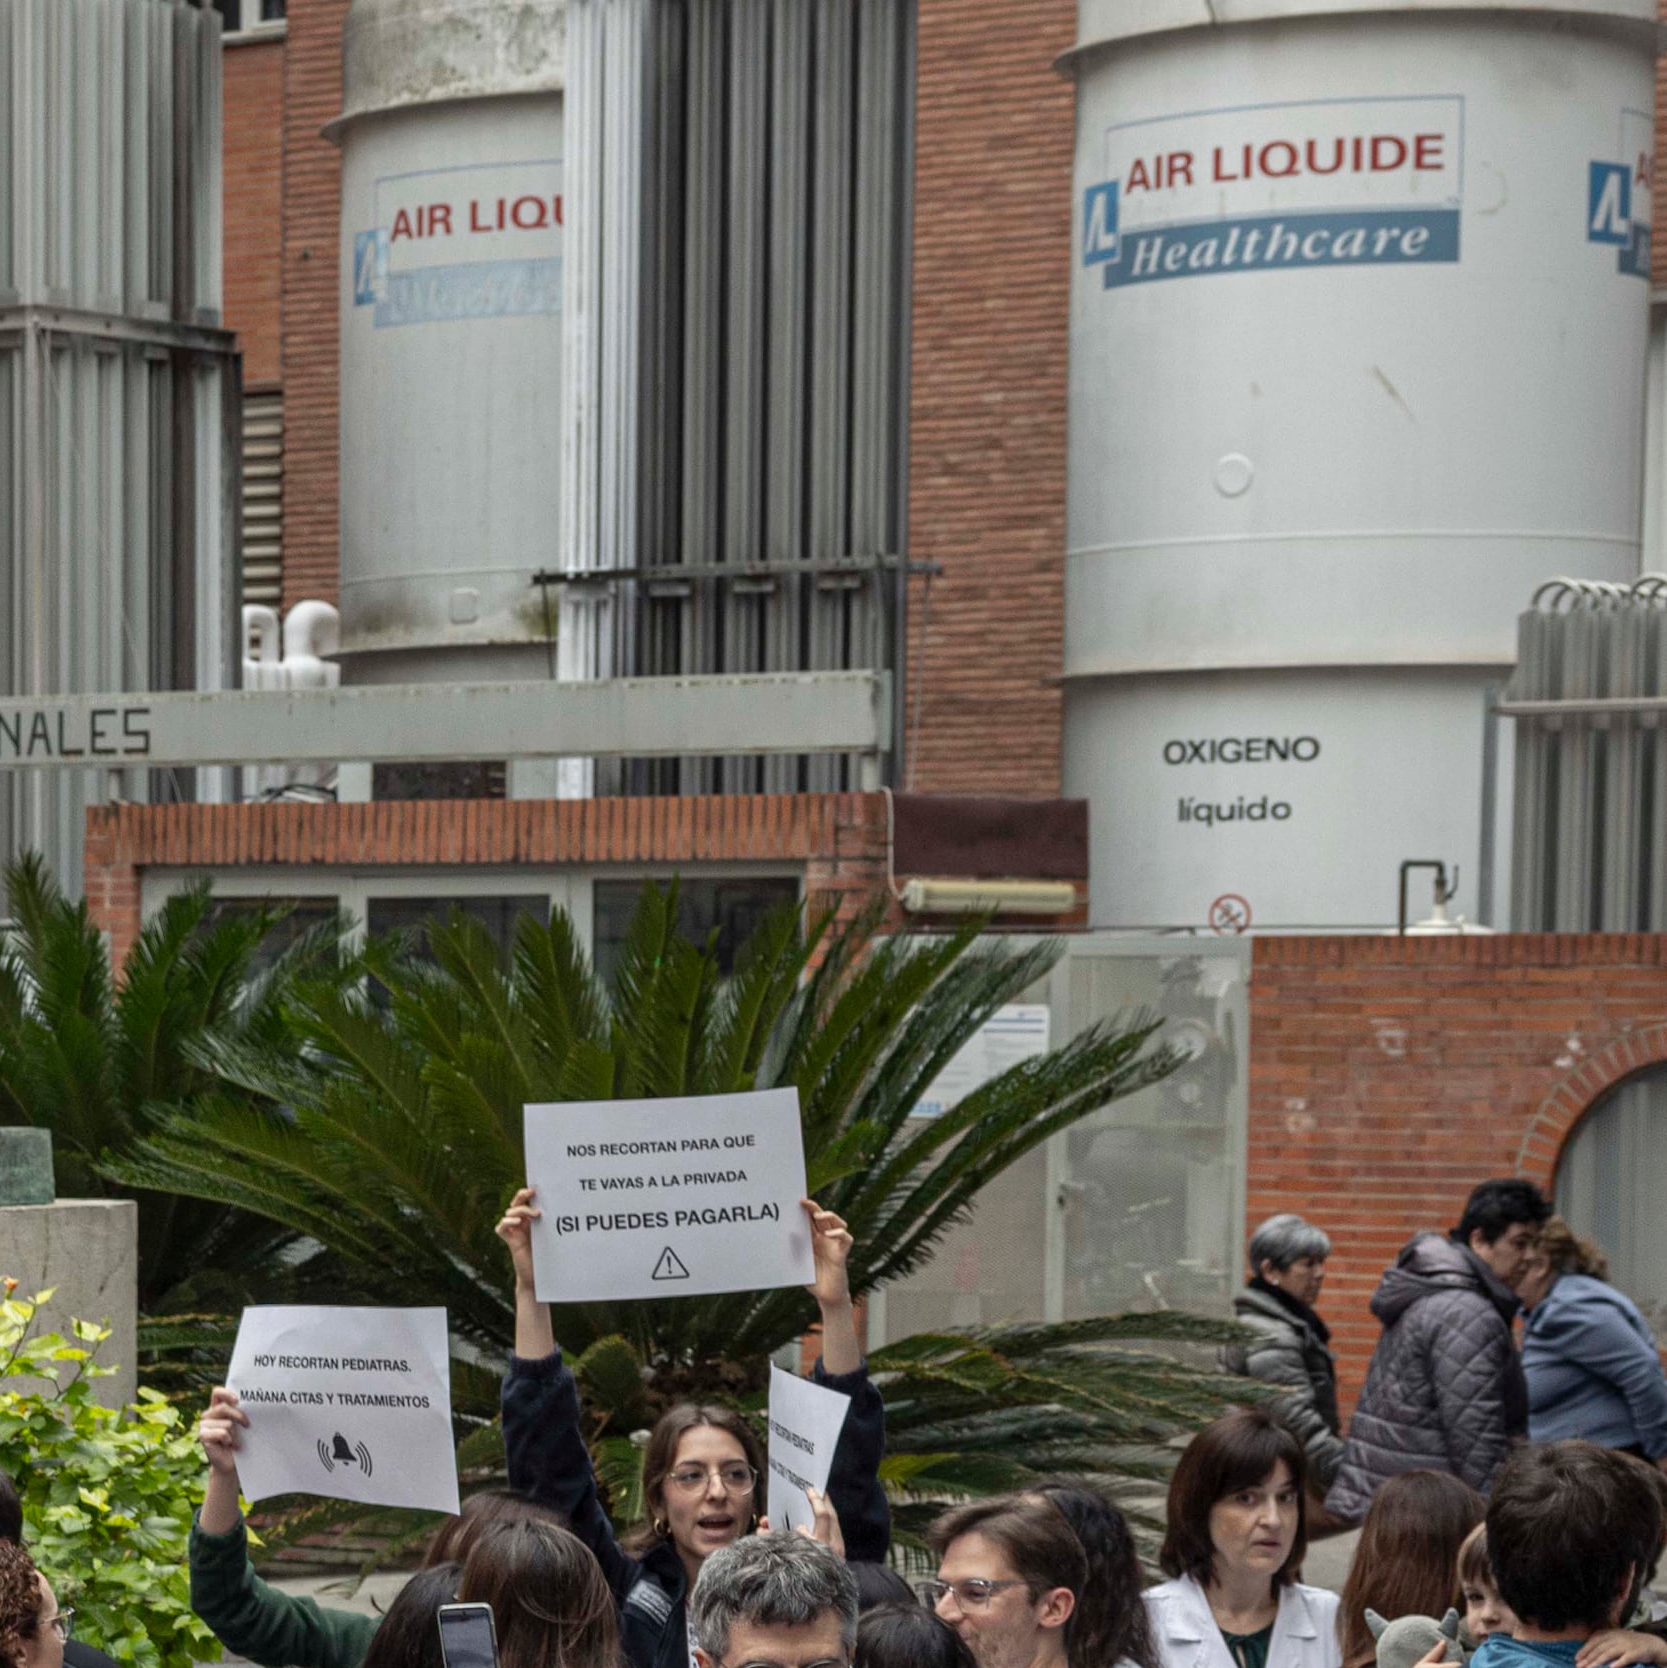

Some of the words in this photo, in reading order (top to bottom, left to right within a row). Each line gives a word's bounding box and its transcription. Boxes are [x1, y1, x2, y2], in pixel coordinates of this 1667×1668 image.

[1125, 152, 1193, 195] AIR
[1213, 133, 1445, 182] LIQUIDE
[390, 203, 453, 241] AIR
[1132, 219, 1431, 276] Healthcare
[1164, 736, 1320, 765] OXIGENO
[1178, 796, 1291, 827] líquido
[567, 1145, 596, 1158] NOS
[600, 1141, 677, 1156] RECORTAN
[681, 1139, 720, 1152] PARA
[723, 1135, 755, 1148] QUE
[580, 1178, 597, 1191] TE
[601, 1176, 644, 1190] VAYAS
[648, 1177, 658, 1188] A
[661, 1175, 680, 1187] LA
[684, 1170, 747, 1186] PRIVADA
[556, 1216, 580, 1235] (SI
[586, 1211, 669, 1232] PUEDES
[675, 1203, 780, 1227] PAGARLA)
[254, 1355, 277, 1368] HOY
[279, 1356, 338, 1370] RECORTAN
[342, 1358, 411, 1372] PEDIATRAS.
[240, 1388, 287, 1403] MAÑANA
[290, 1392, 323, 1405] CITAS
[327, 1393, 336, 1405] Y
[337, 1394, 430, 1408] TRATAMIENTOS
